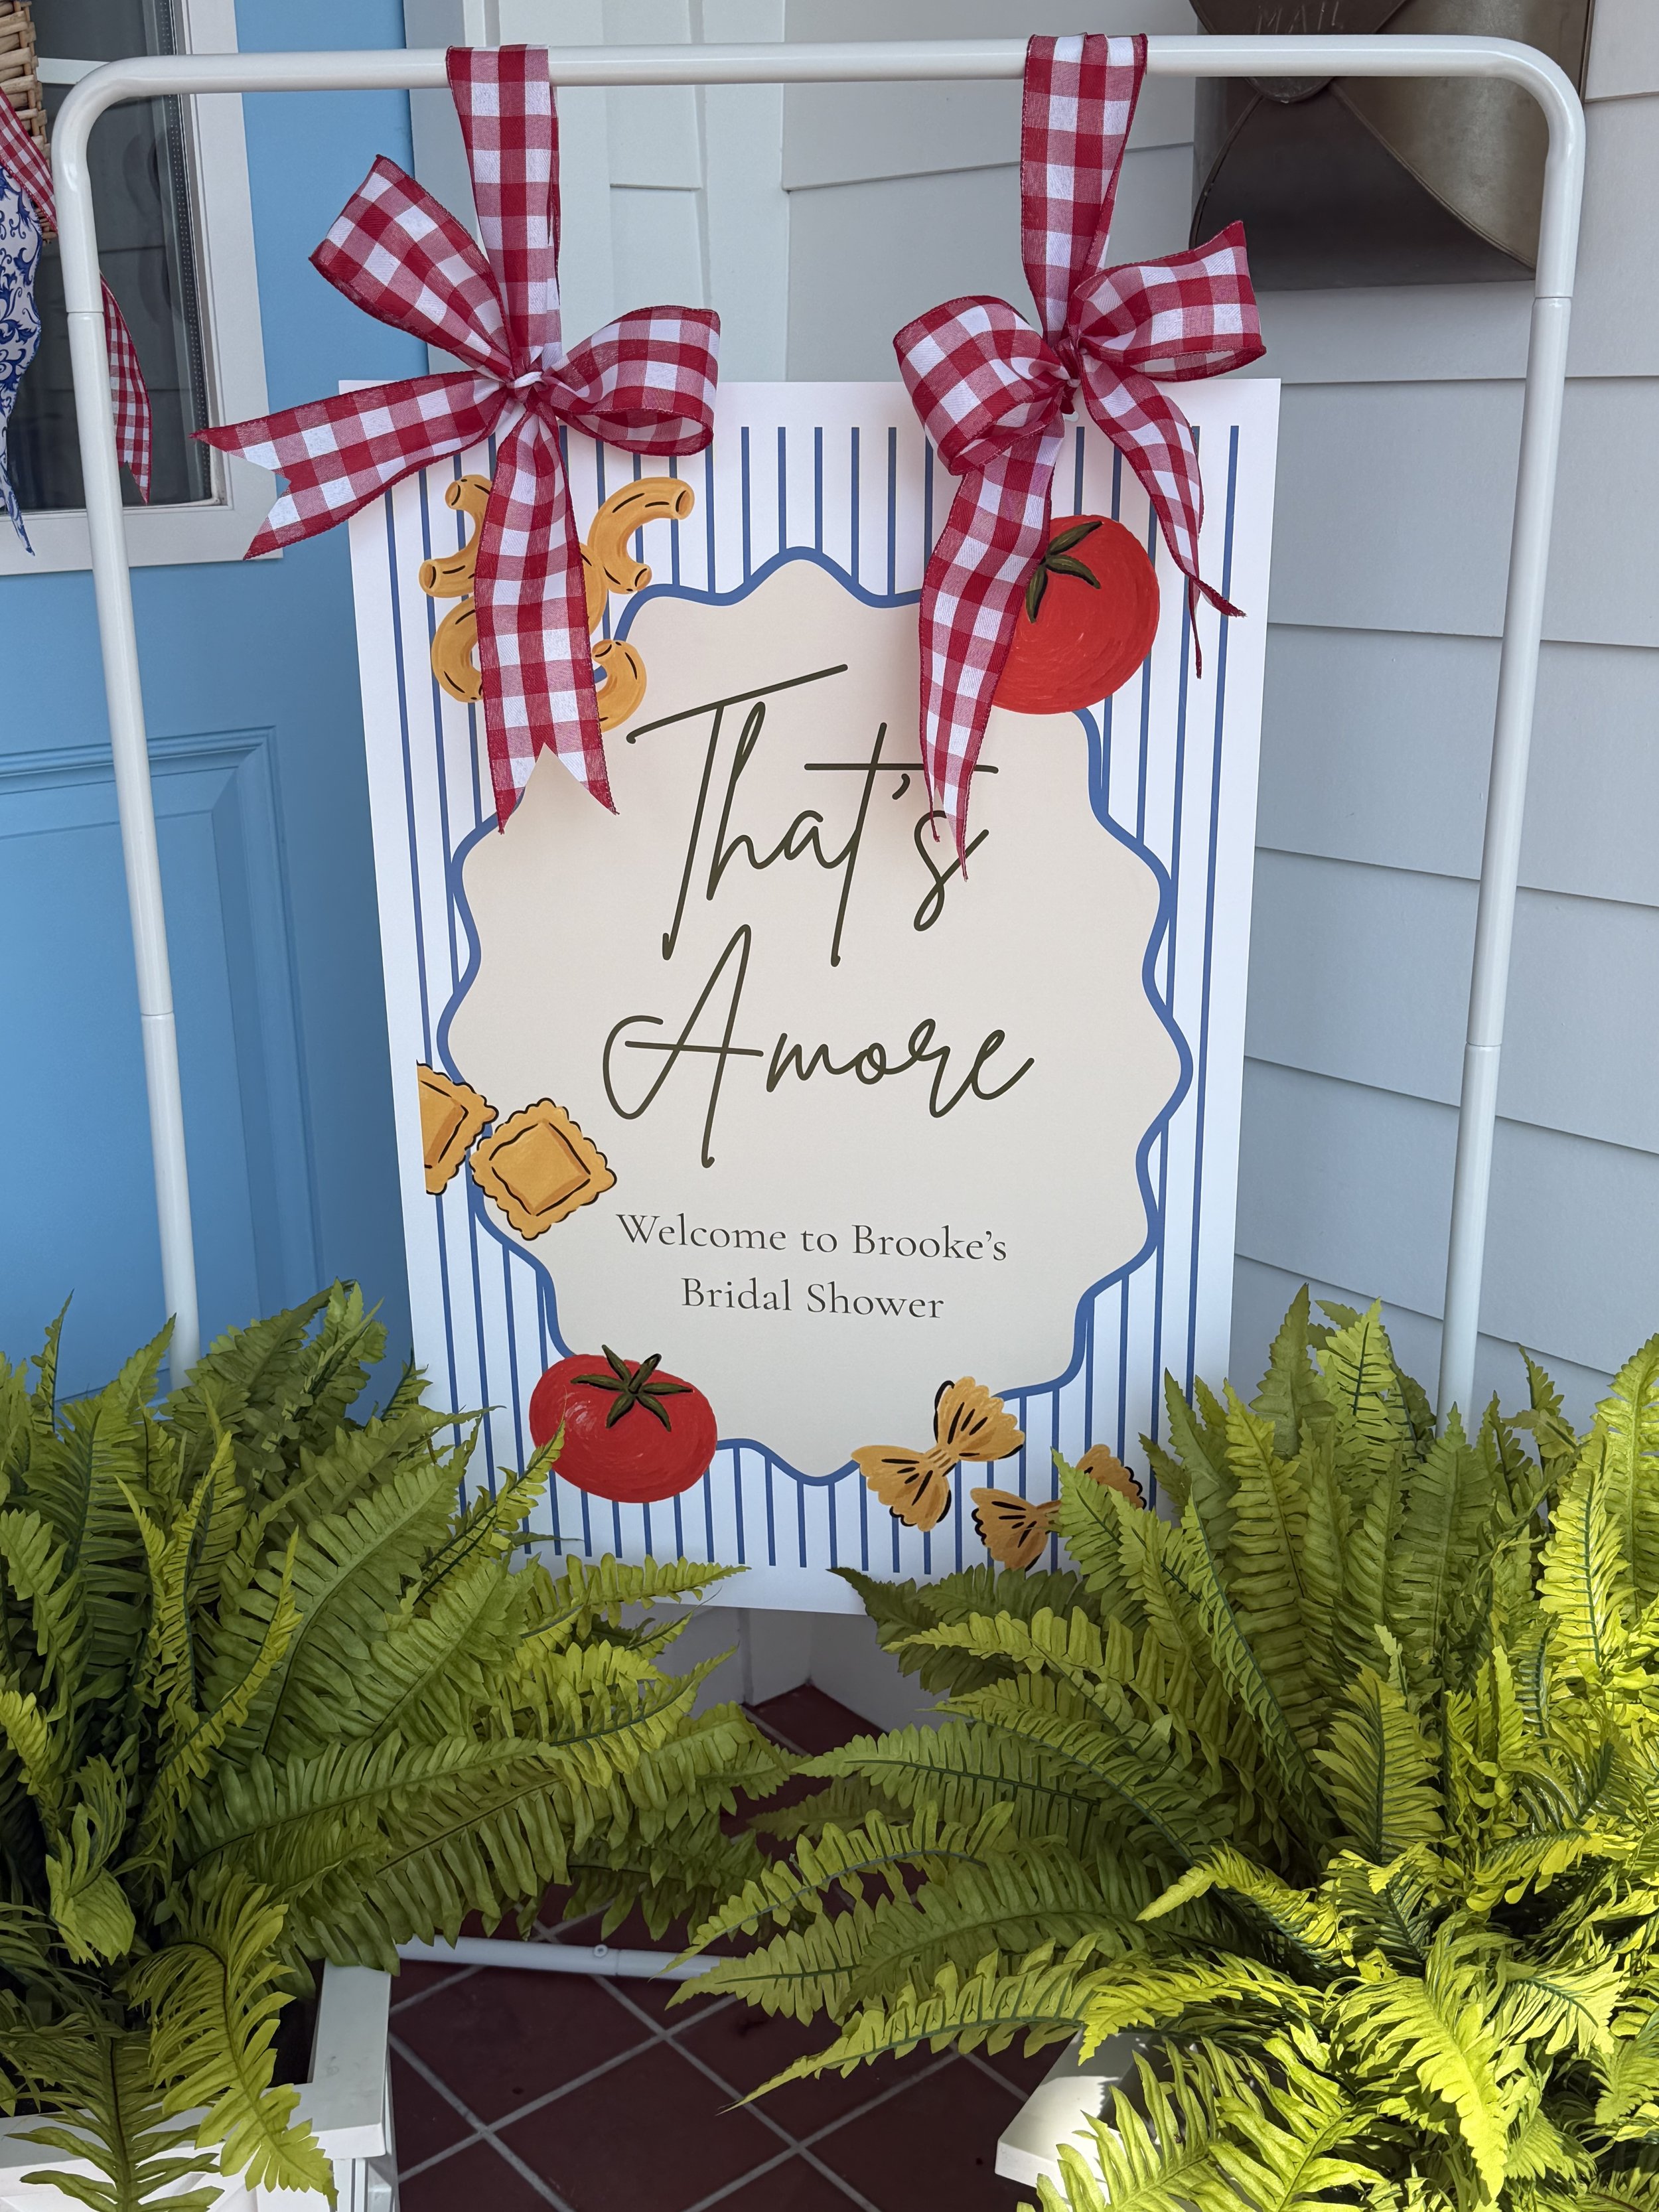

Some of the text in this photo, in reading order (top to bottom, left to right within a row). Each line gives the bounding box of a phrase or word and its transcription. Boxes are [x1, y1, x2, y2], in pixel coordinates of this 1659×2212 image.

[1255, 1, 1344, 35] MAIL
[626, 664, 998, 967] That’s
[603, 924, 1035, 1168] Amore
[615, 1213, 1007, 1261] Welcome to Brooke’s
[681, 1277, 945, 1319] Bridal Shower
